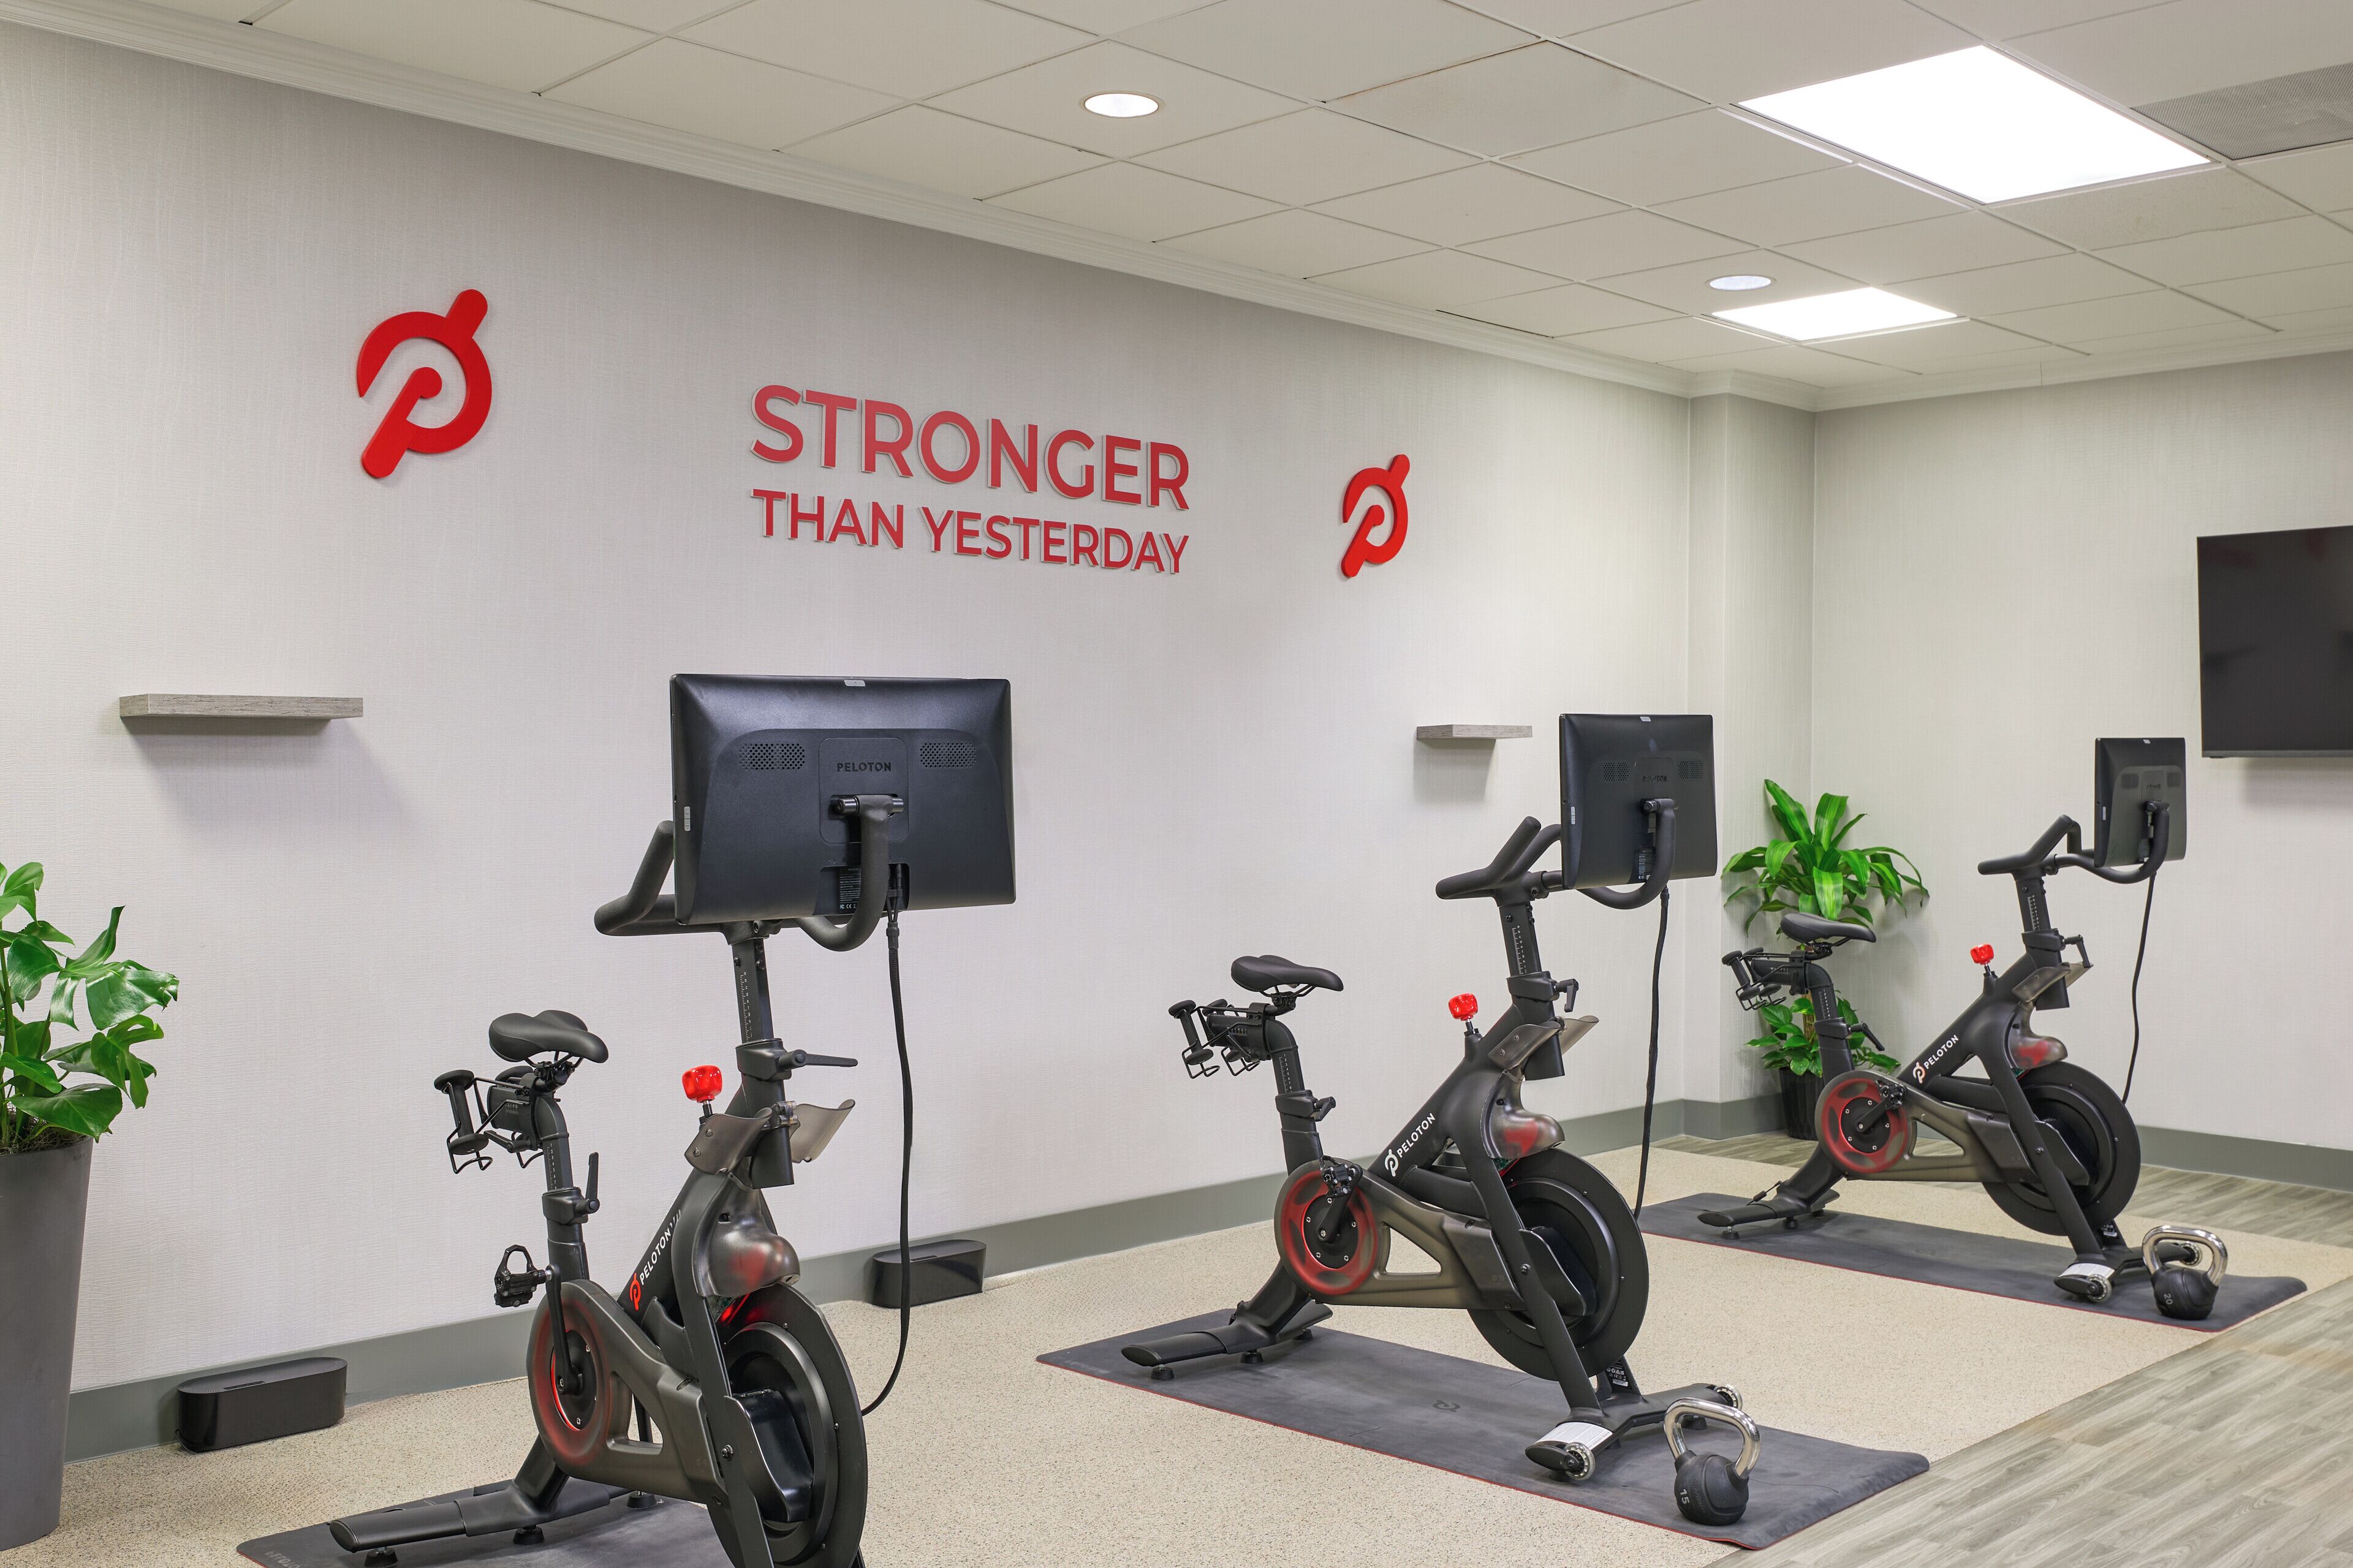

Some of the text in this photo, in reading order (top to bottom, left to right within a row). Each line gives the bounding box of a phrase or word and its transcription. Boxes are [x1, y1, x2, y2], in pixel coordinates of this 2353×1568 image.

[751, 384, 1189, 510] STRONGER
[751, 488, 1189, 574] THAN YESTERDAY
[837, 762, 892, 772] PELOTON
[1923, 1034, 1959, 1069] PELOTON
[1396, 1113, 1436, 1158] PELOTON
[639, 1227, 672, 1286] PELOTON
[2164, 1293, 2173, 1305] 20
[1680, 1488, 1690, 1504] 15
